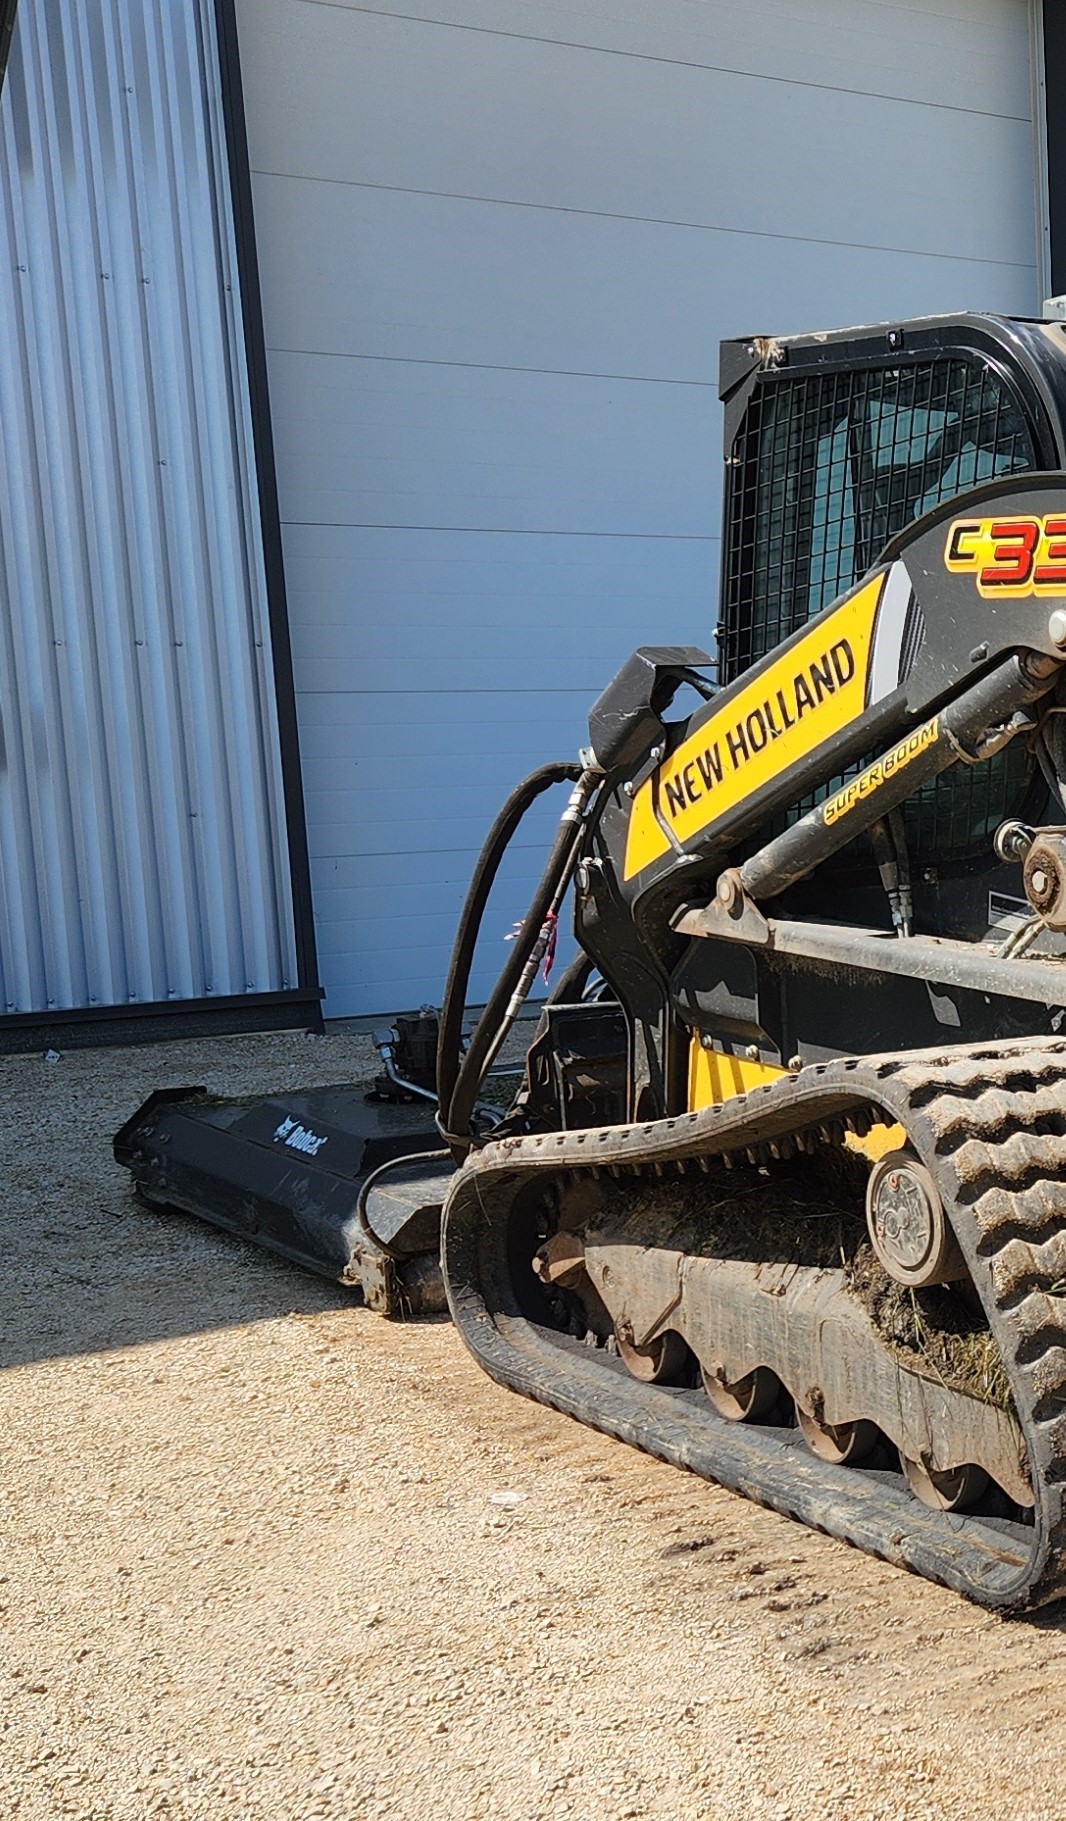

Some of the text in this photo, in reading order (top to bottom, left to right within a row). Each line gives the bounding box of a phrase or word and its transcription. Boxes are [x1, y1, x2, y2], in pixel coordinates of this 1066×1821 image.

[664, 638, 855, 818] NEW HOLLAND
[824, 719, 938, 824] SUPER BOOM
